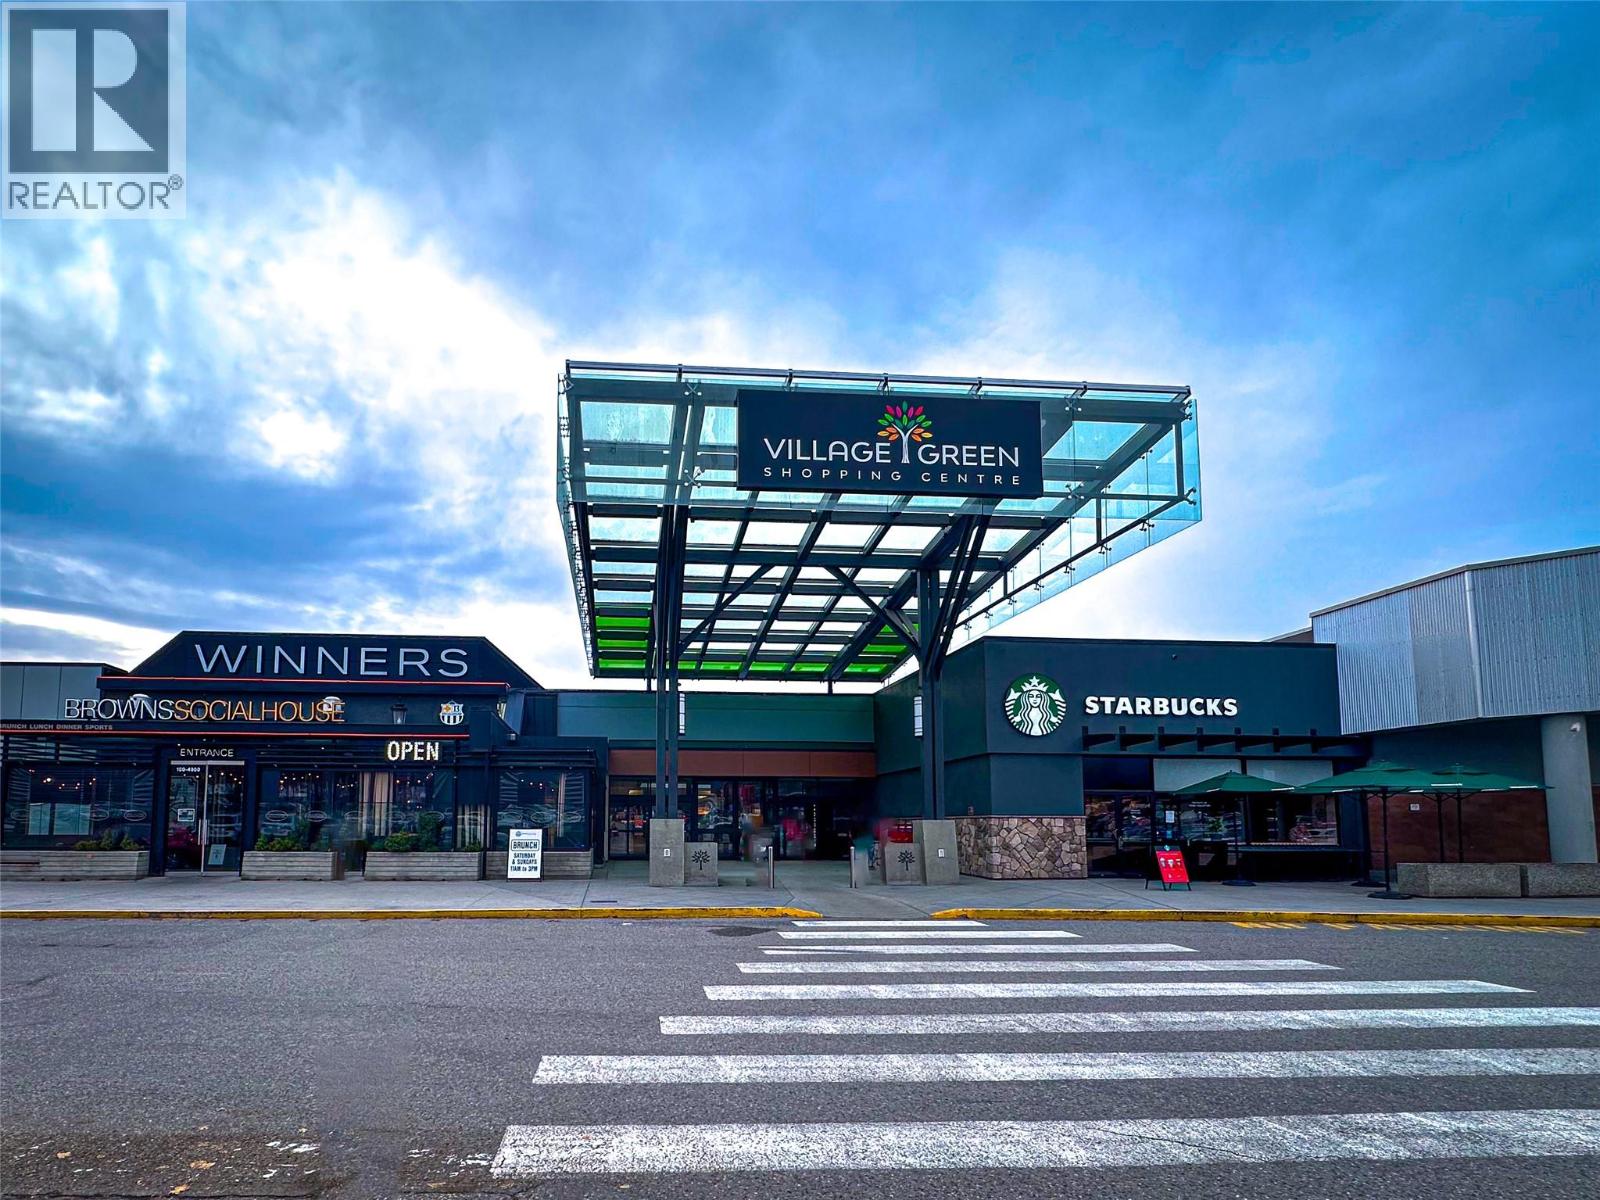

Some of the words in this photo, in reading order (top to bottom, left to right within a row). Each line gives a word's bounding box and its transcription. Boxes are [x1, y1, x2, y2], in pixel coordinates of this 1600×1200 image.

[763, 438, 891, 464] VILLAGE
[918, 443, 1020, 467] GREEN
[763, 466, 902, 482] SHOPPING
[921, 472, 1021, 485] CENTRE
[195, 644, 469, 678] WINNERS
[1085, 696, 1239, 717] STARBUCKS
[179, 748, 235, 757] ENTRANCE
[387, 740, 440, 761] OPEN
[513, 841, 538, 849] BRUNCH
